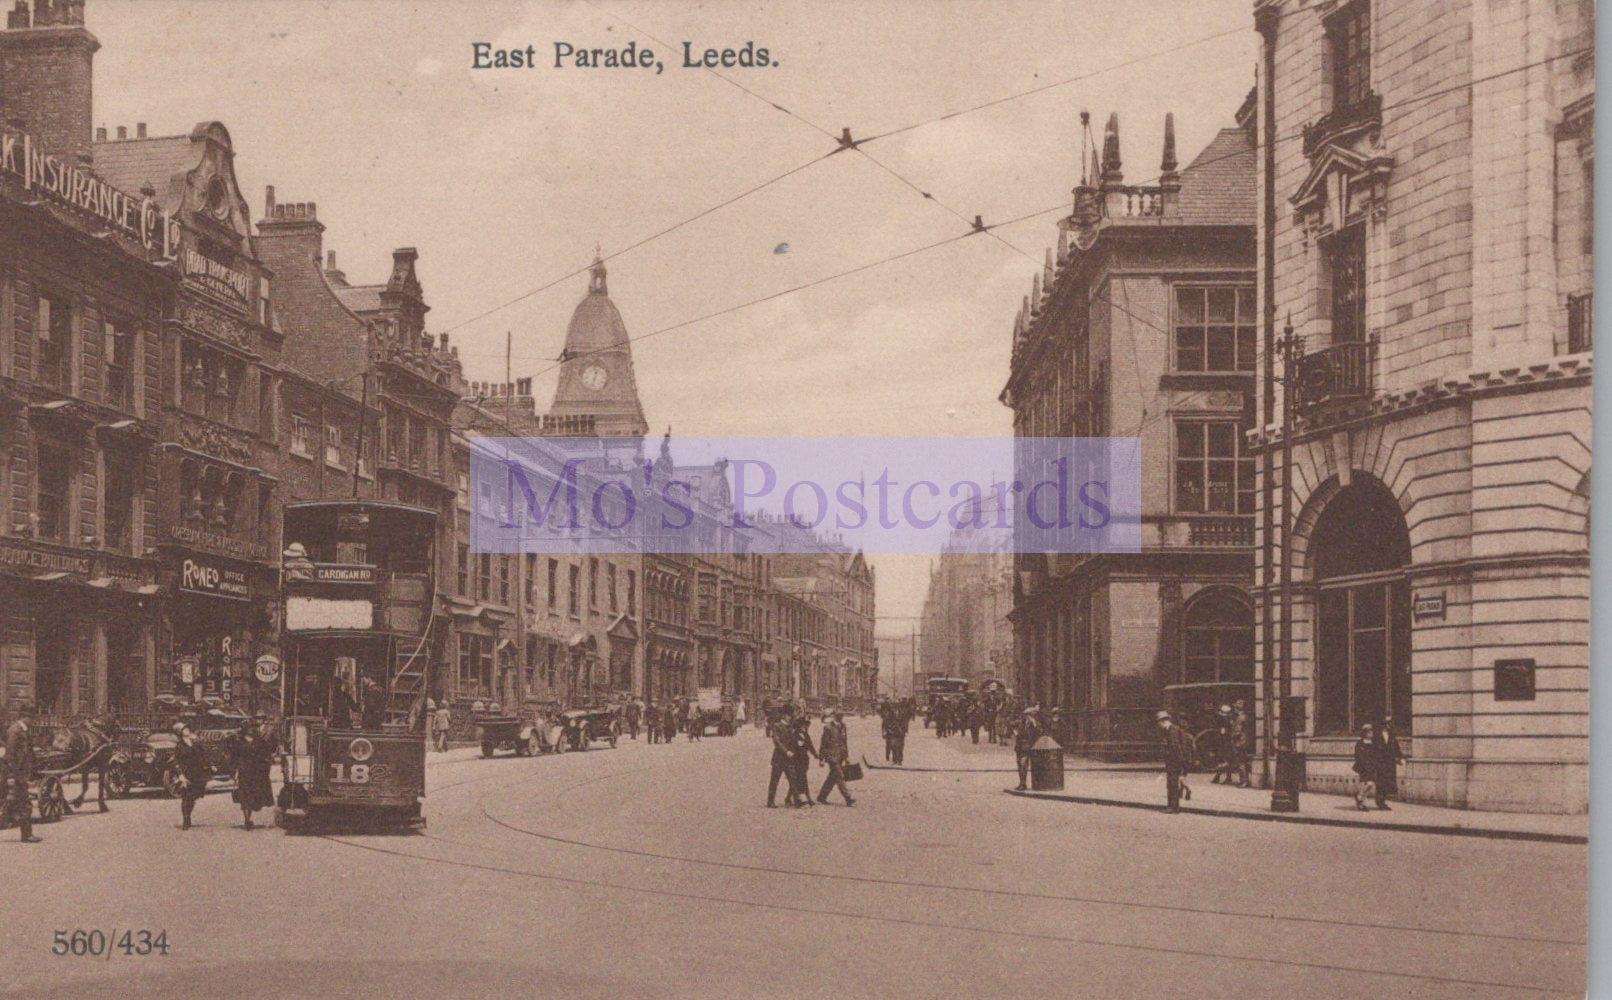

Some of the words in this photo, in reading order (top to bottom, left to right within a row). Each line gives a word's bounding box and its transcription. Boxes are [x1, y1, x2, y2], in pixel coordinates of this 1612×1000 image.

[24, 134, 137, 232] INSURANCE
[183, 559, 219, 588] RONEO
[318, 569, 359, 579] CARDIGAN
[222, 636, 231, 700] RONEO
